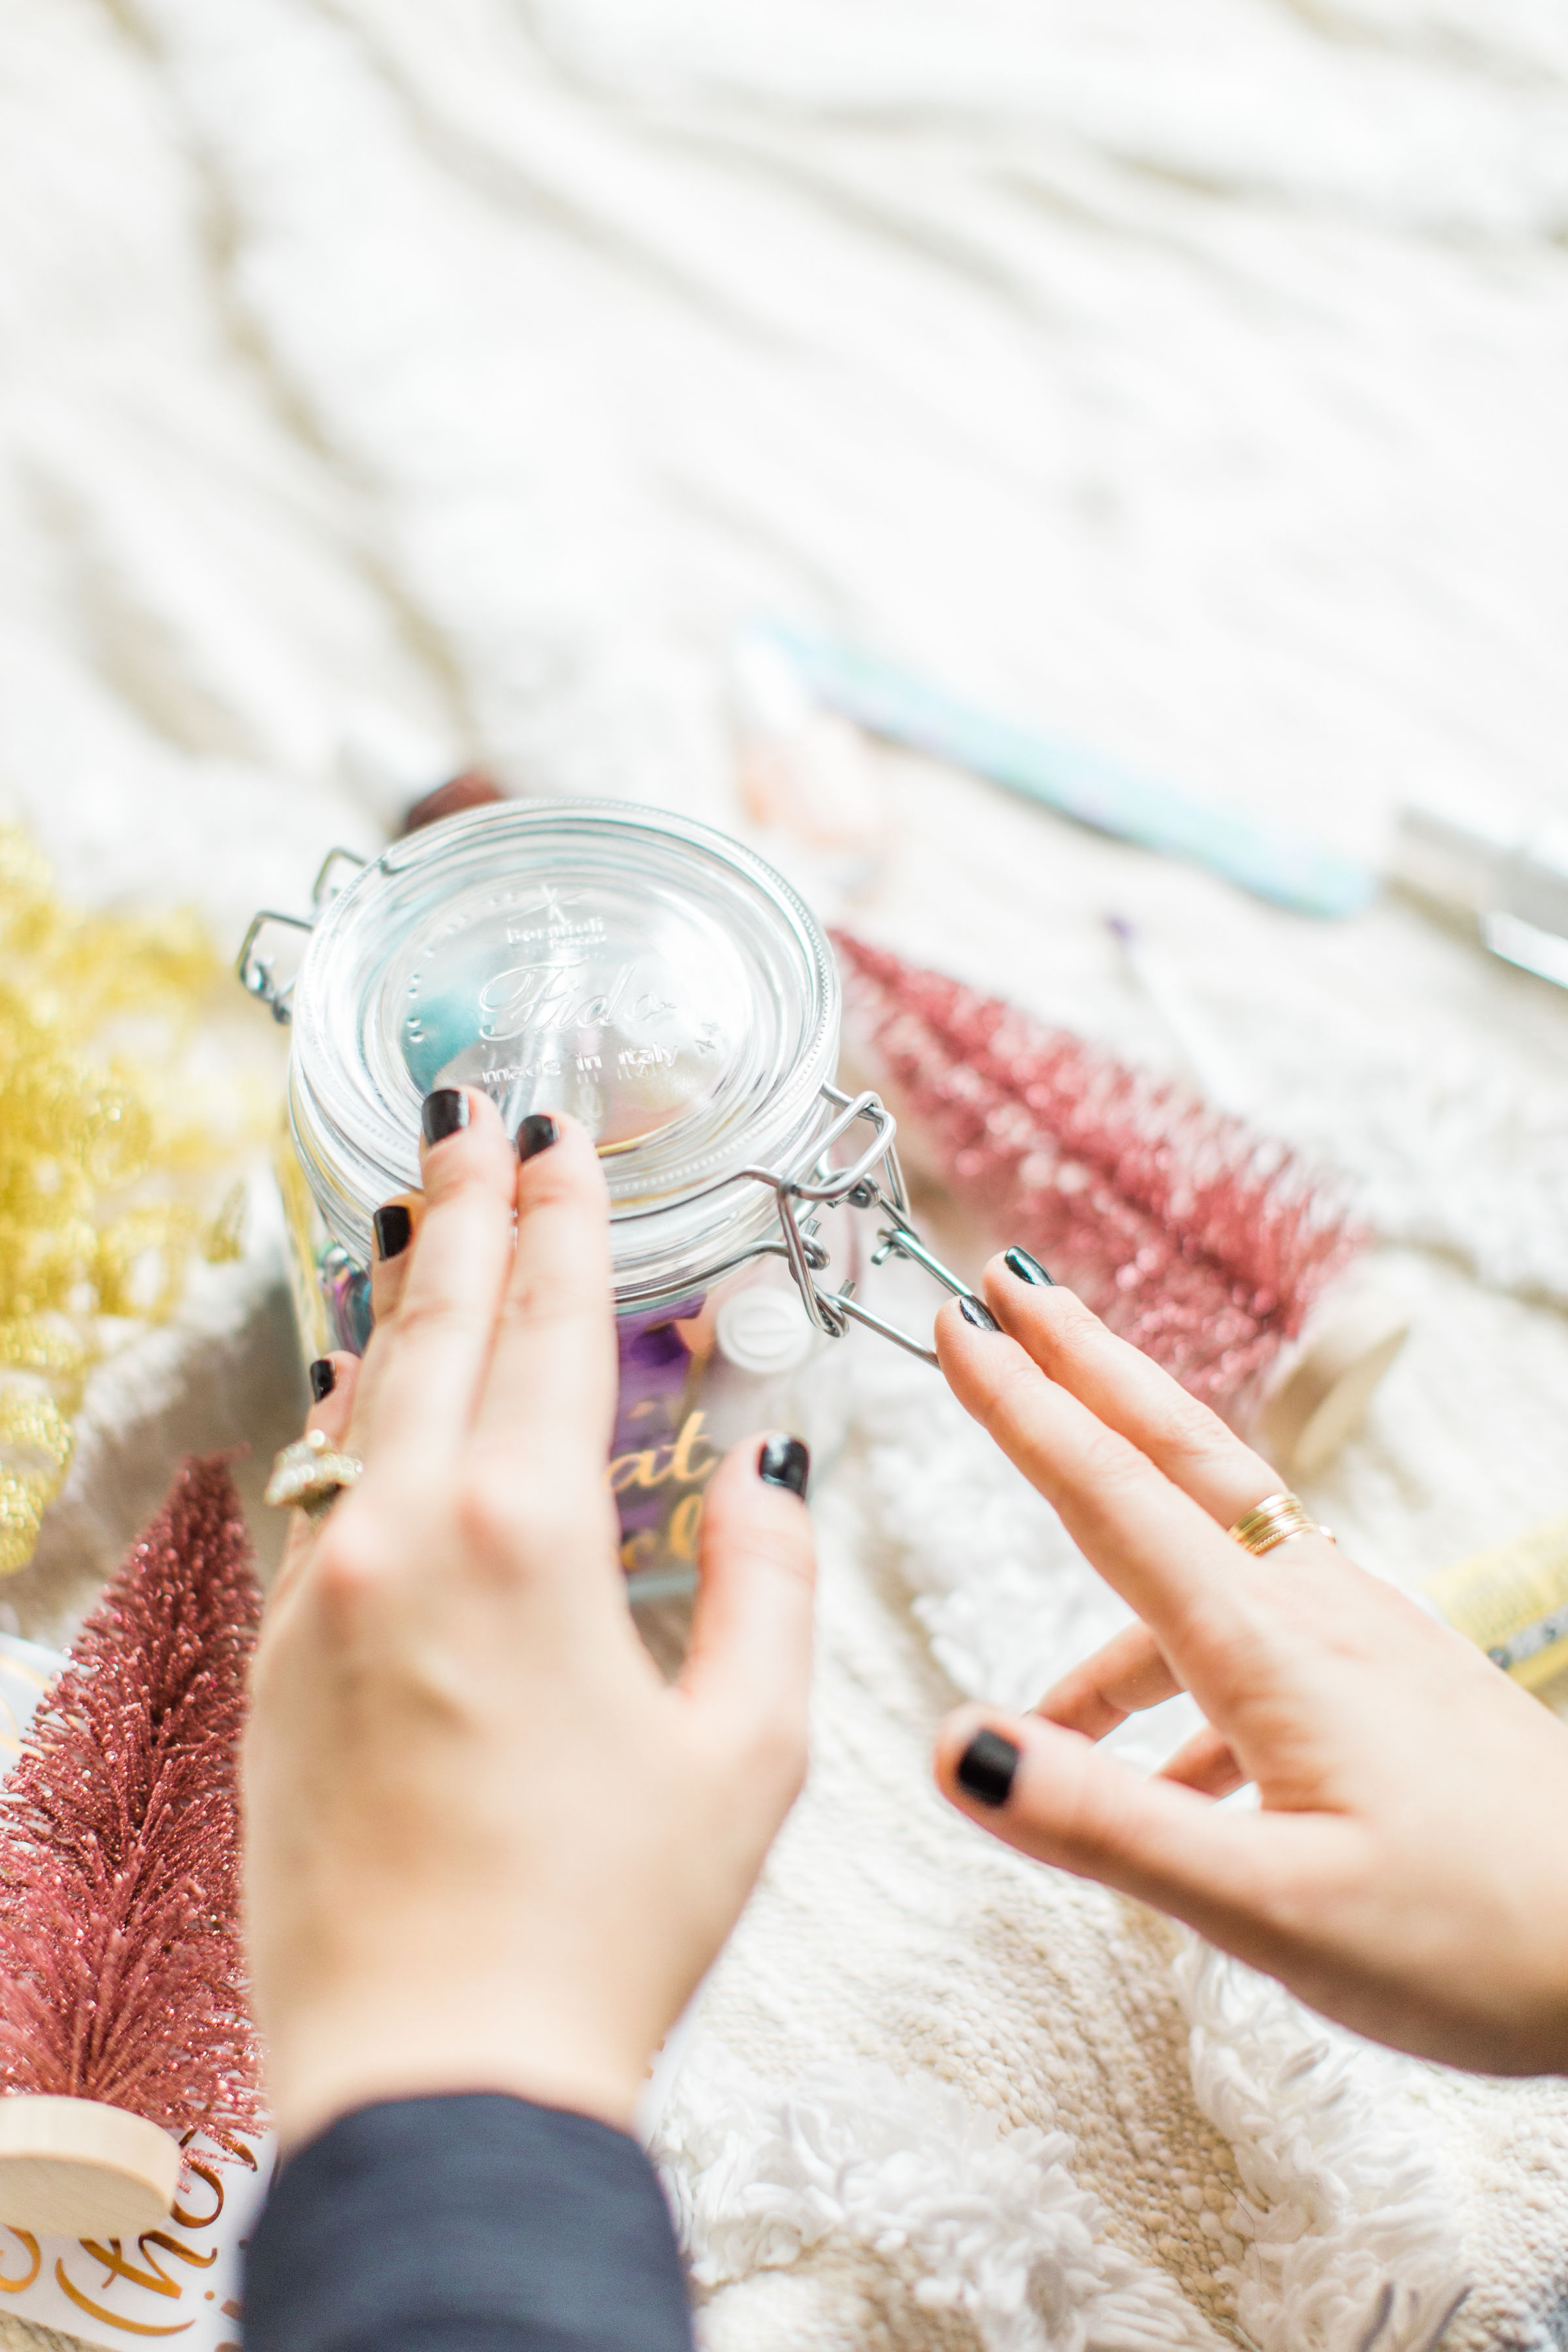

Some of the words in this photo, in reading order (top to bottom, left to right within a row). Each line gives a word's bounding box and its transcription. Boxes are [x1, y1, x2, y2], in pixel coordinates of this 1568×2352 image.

[479, 956, 677, 1041] Fido
[482, 1056, 561, 1083] made
[575, 1052, 602, 1071] in
